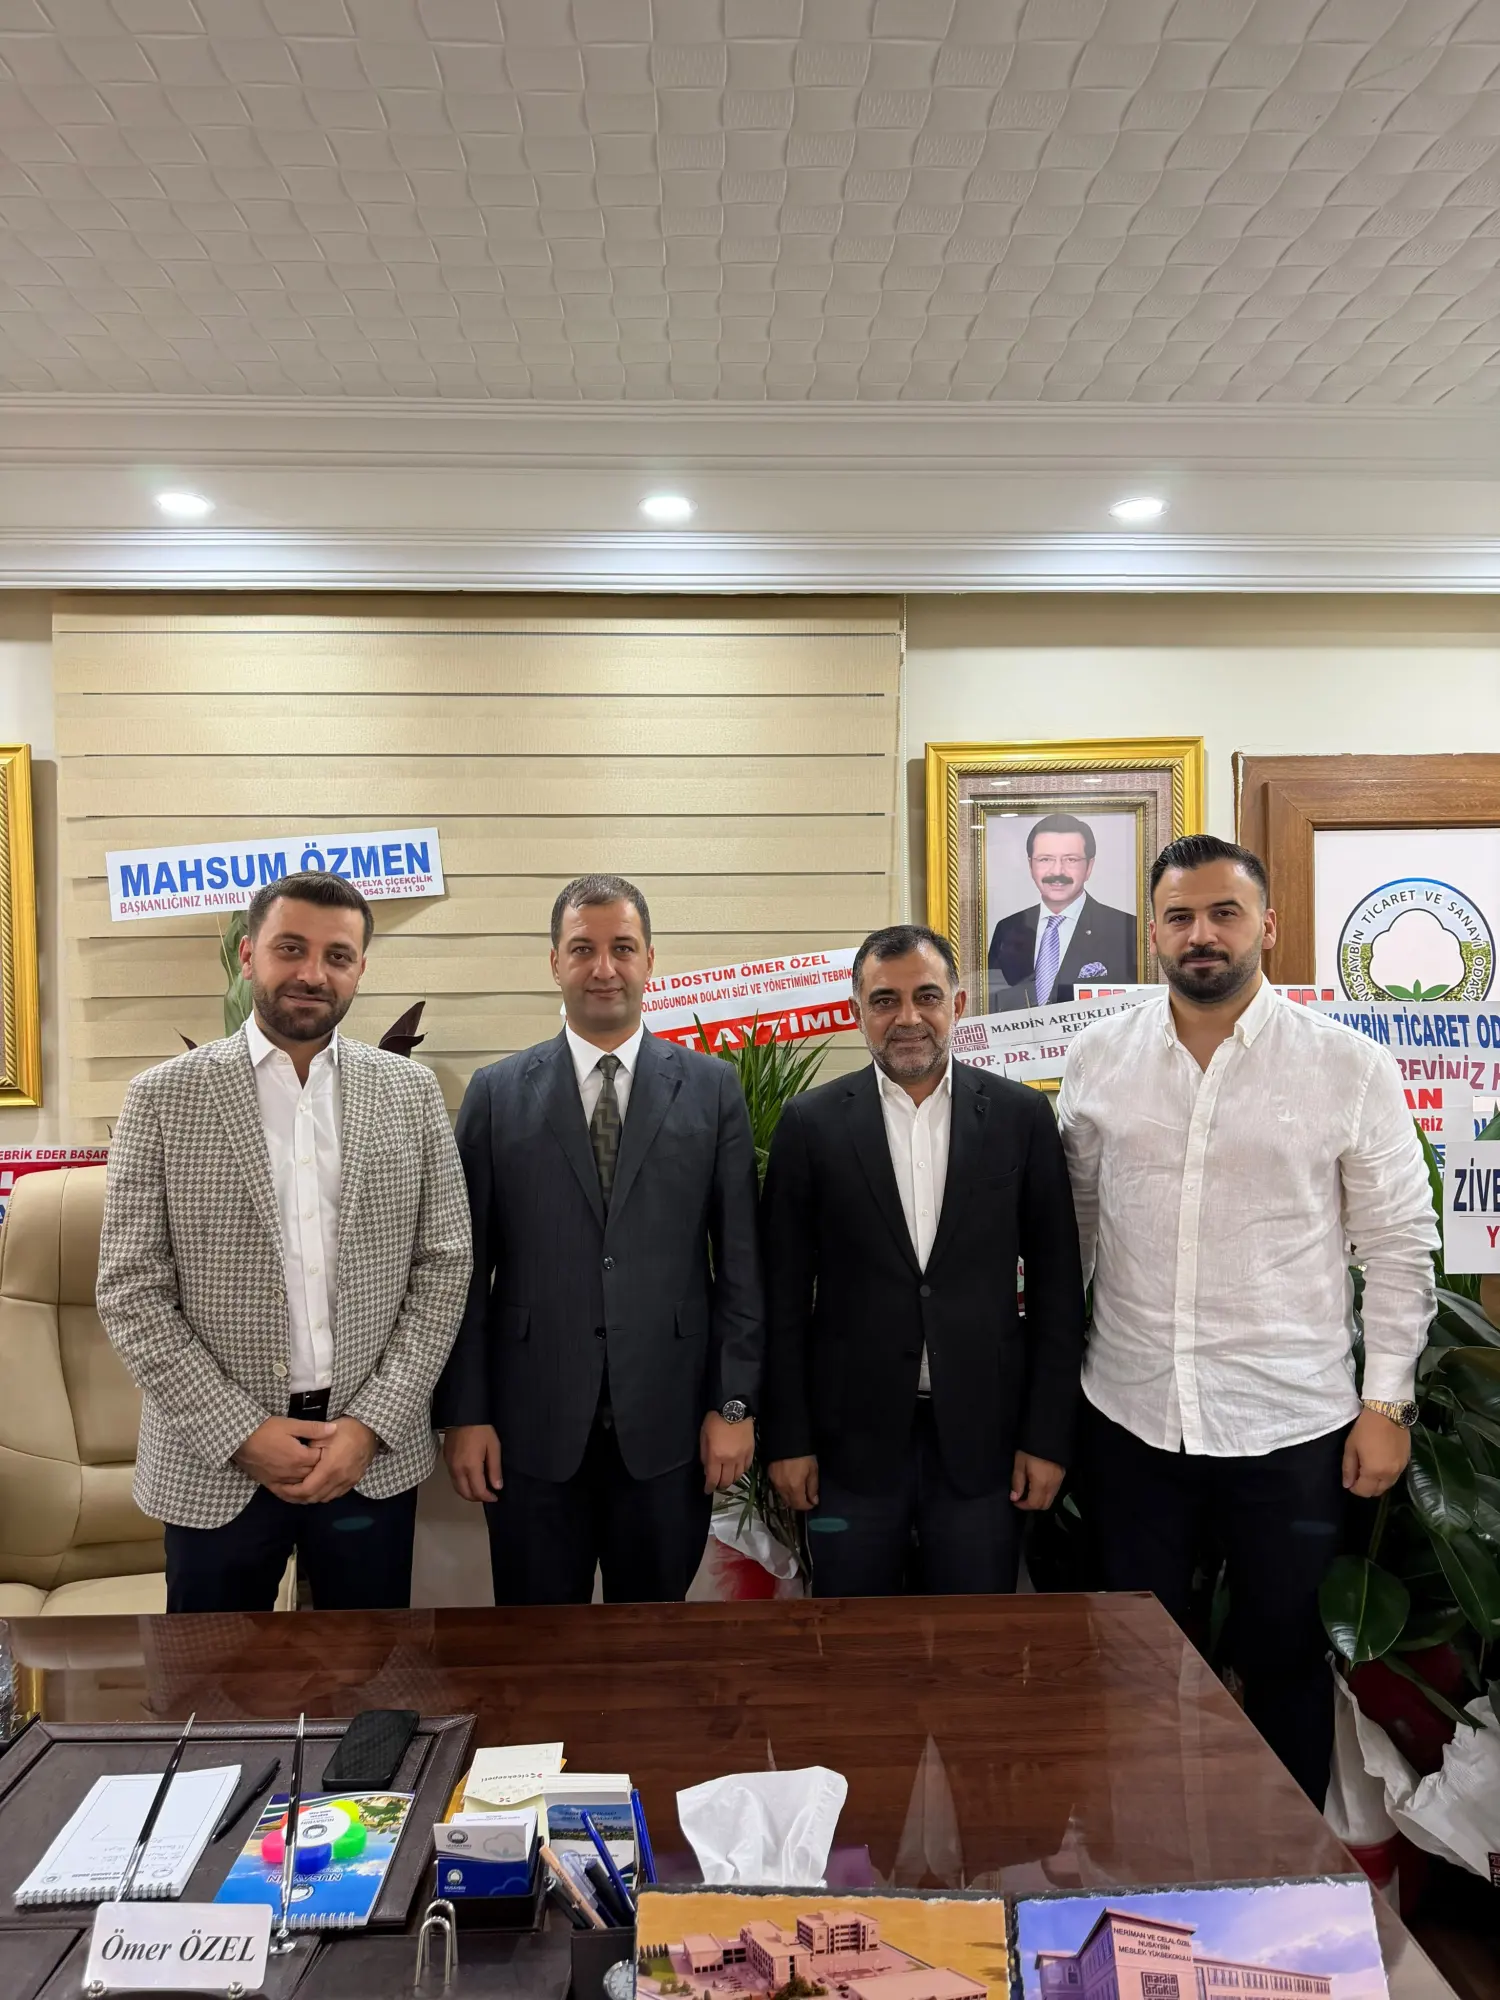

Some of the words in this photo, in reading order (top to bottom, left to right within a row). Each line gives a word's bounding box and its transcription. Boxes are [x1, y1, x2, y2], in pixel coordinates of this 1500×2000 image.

[120, 852, 288, 898] MAHSUM
[300, 842, 431, 879] ÖZMEN
[385, 875, 433, 887] ÇİÇEKÇİLİK
[120, 893, 201, 915] BAŞKANLIĞINIZ
[204, 892, 246, 906] HAYIRLI
[363, 887, 384, 896] 0543
[386, 886, 401, 894] 742
[415, 884, 426, 892] 30
[1361, 890, 1416, 925] TİCARET
[1424, 890, 1443, 905] VE
[1446, 901, 1487, 948] SANAYİ
[670, 968, 736, 989] DOSTUM
[741, 961, 785, 977] ÖMER
[790, 954, 830, 969] ÖZEL
[1349, 930, 1373, 1001] NUSAYBİN
[1462, 956, 1486, 1001] ODASI
[641, 993, 698, 1013] OLDUĞUNDAN
[700, 988, 730, 1003] DOLAYI
[732, 982, 748, 997] SİZİ
[750, 983, 762, 995] VE
[763, 971, 820, 993] YÖNETİMİNİZİ
[713, 1009, 856, 1047] AYTİMU
[991, 1019, 1044, 1034] MARDİN
[1049, 1006, 1116, 1025] ARTUKLU
[1393, 1006, 1470, 1048] TİCARET
[1477, 1014, 1500, 1049] OD
[1005, 1051, 1036, 1064] DR.
[1396, 1054, 1486, 1090] REVİNİZ
[36, 1150, 67, 1159] EDER
[70, 1149, 109, 1161] BAŞAR
[101, 1928, 172, 1961] Ömer
[179, 1929, 256, 1962] ÖZEL
